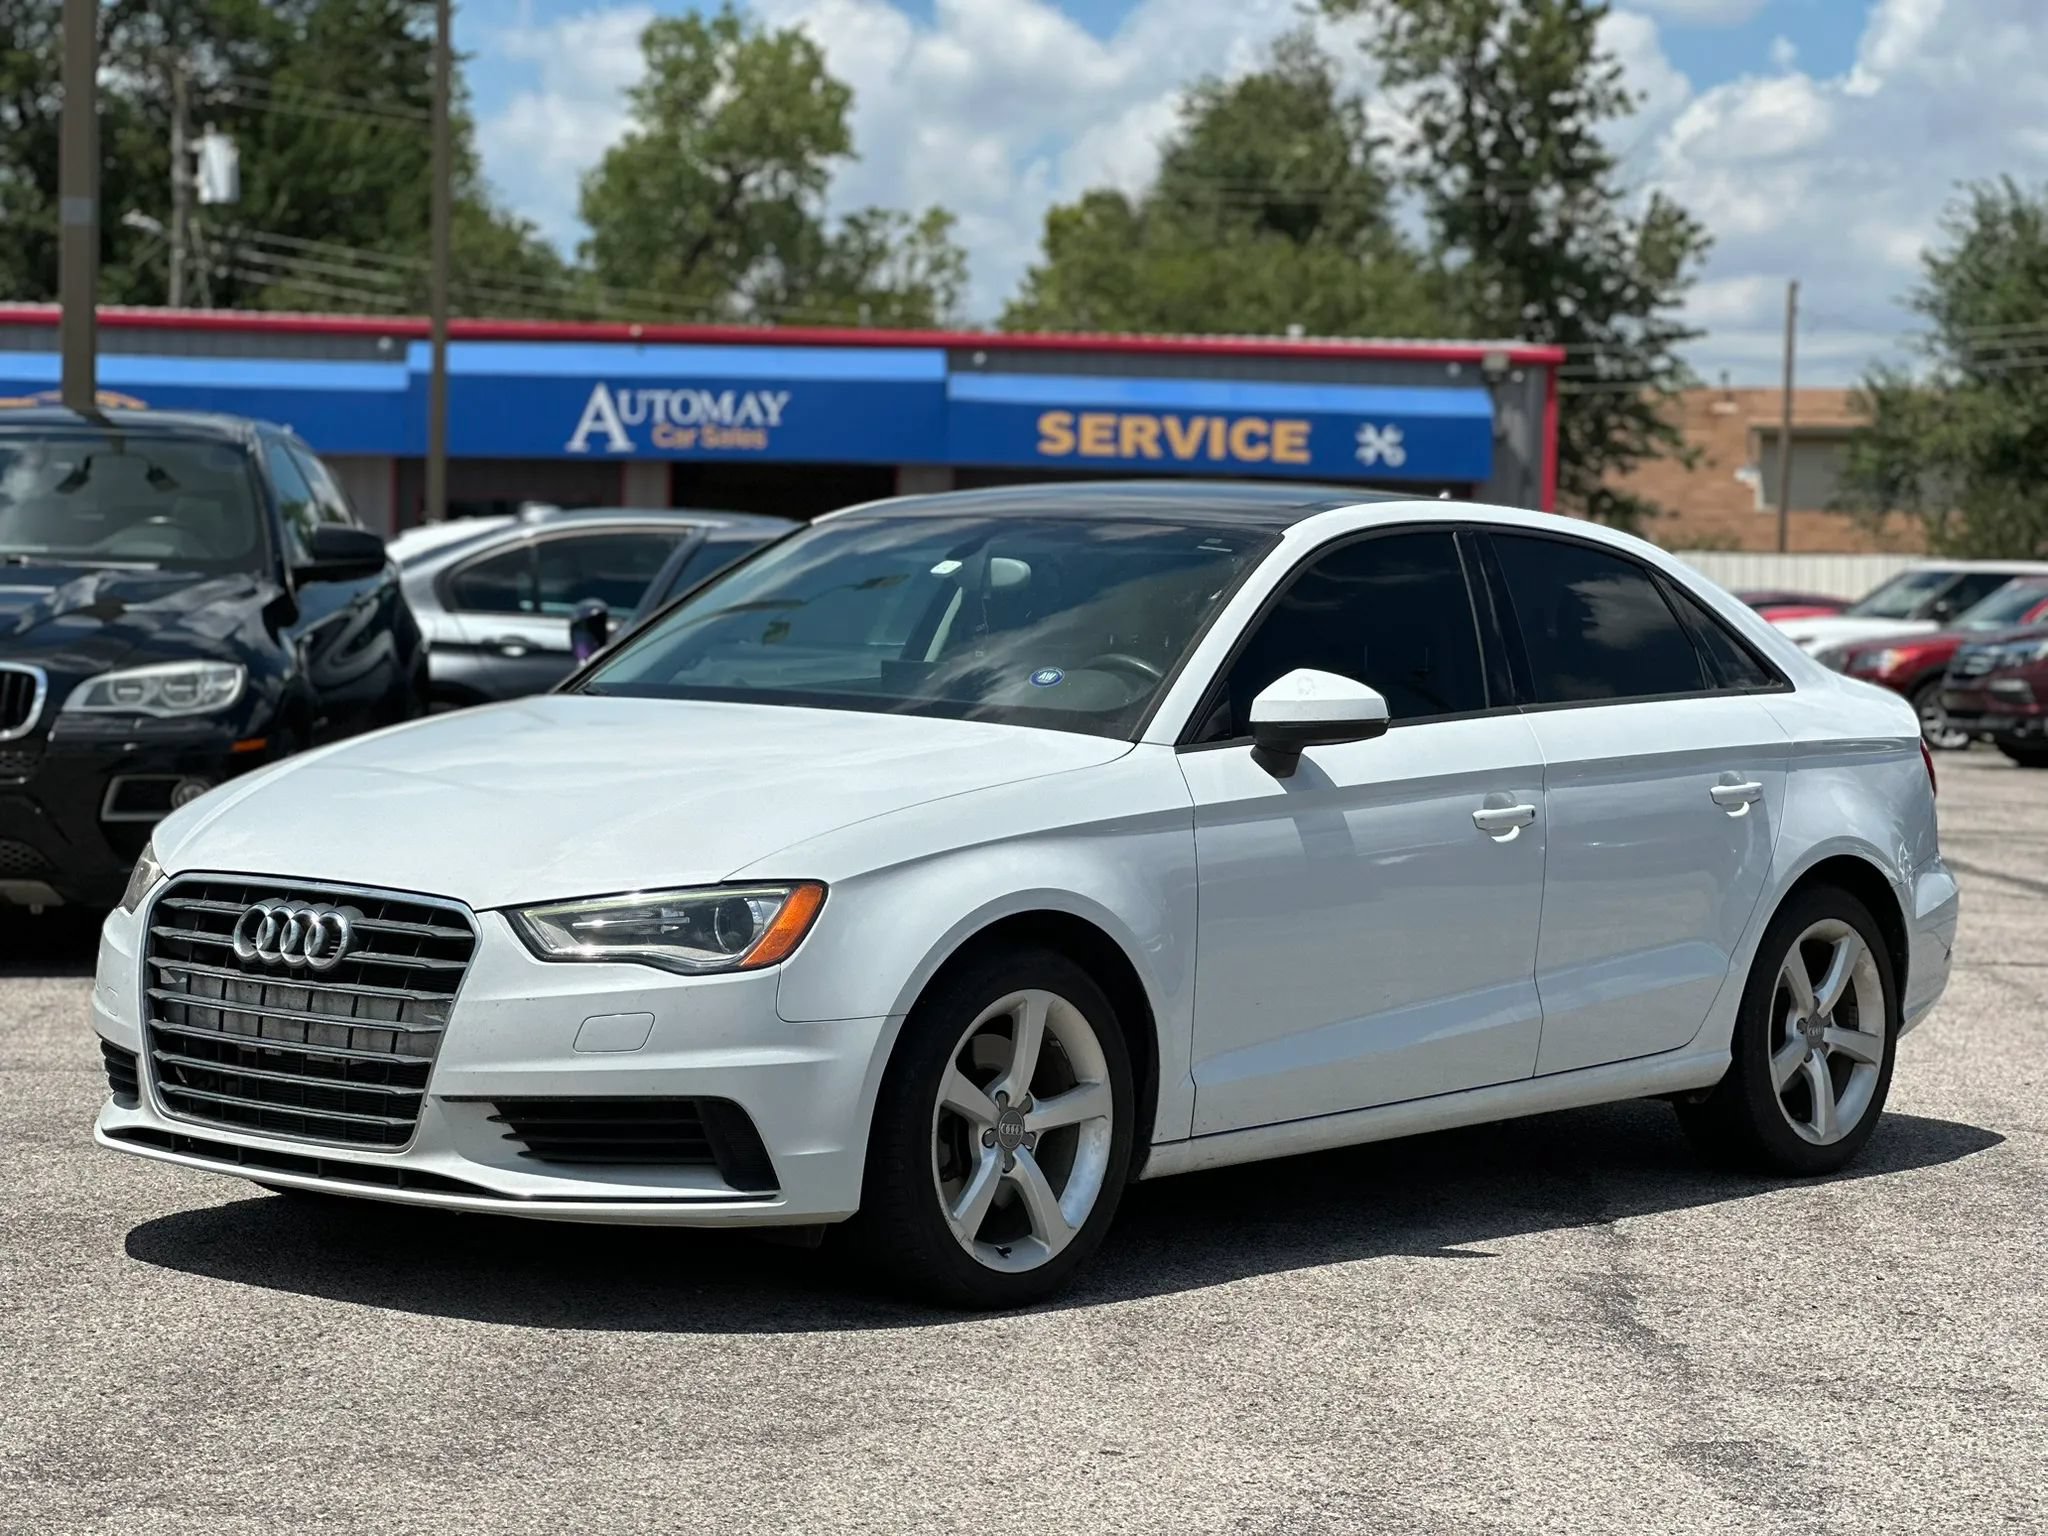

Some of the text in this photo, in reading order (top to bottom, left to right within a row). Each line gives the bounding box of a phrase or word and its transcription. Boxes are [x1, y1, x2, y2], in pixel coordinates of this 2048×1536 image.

[652, 420, 768, 449] Car Sales
[1036, 410, 1312, 464] SERVICE
